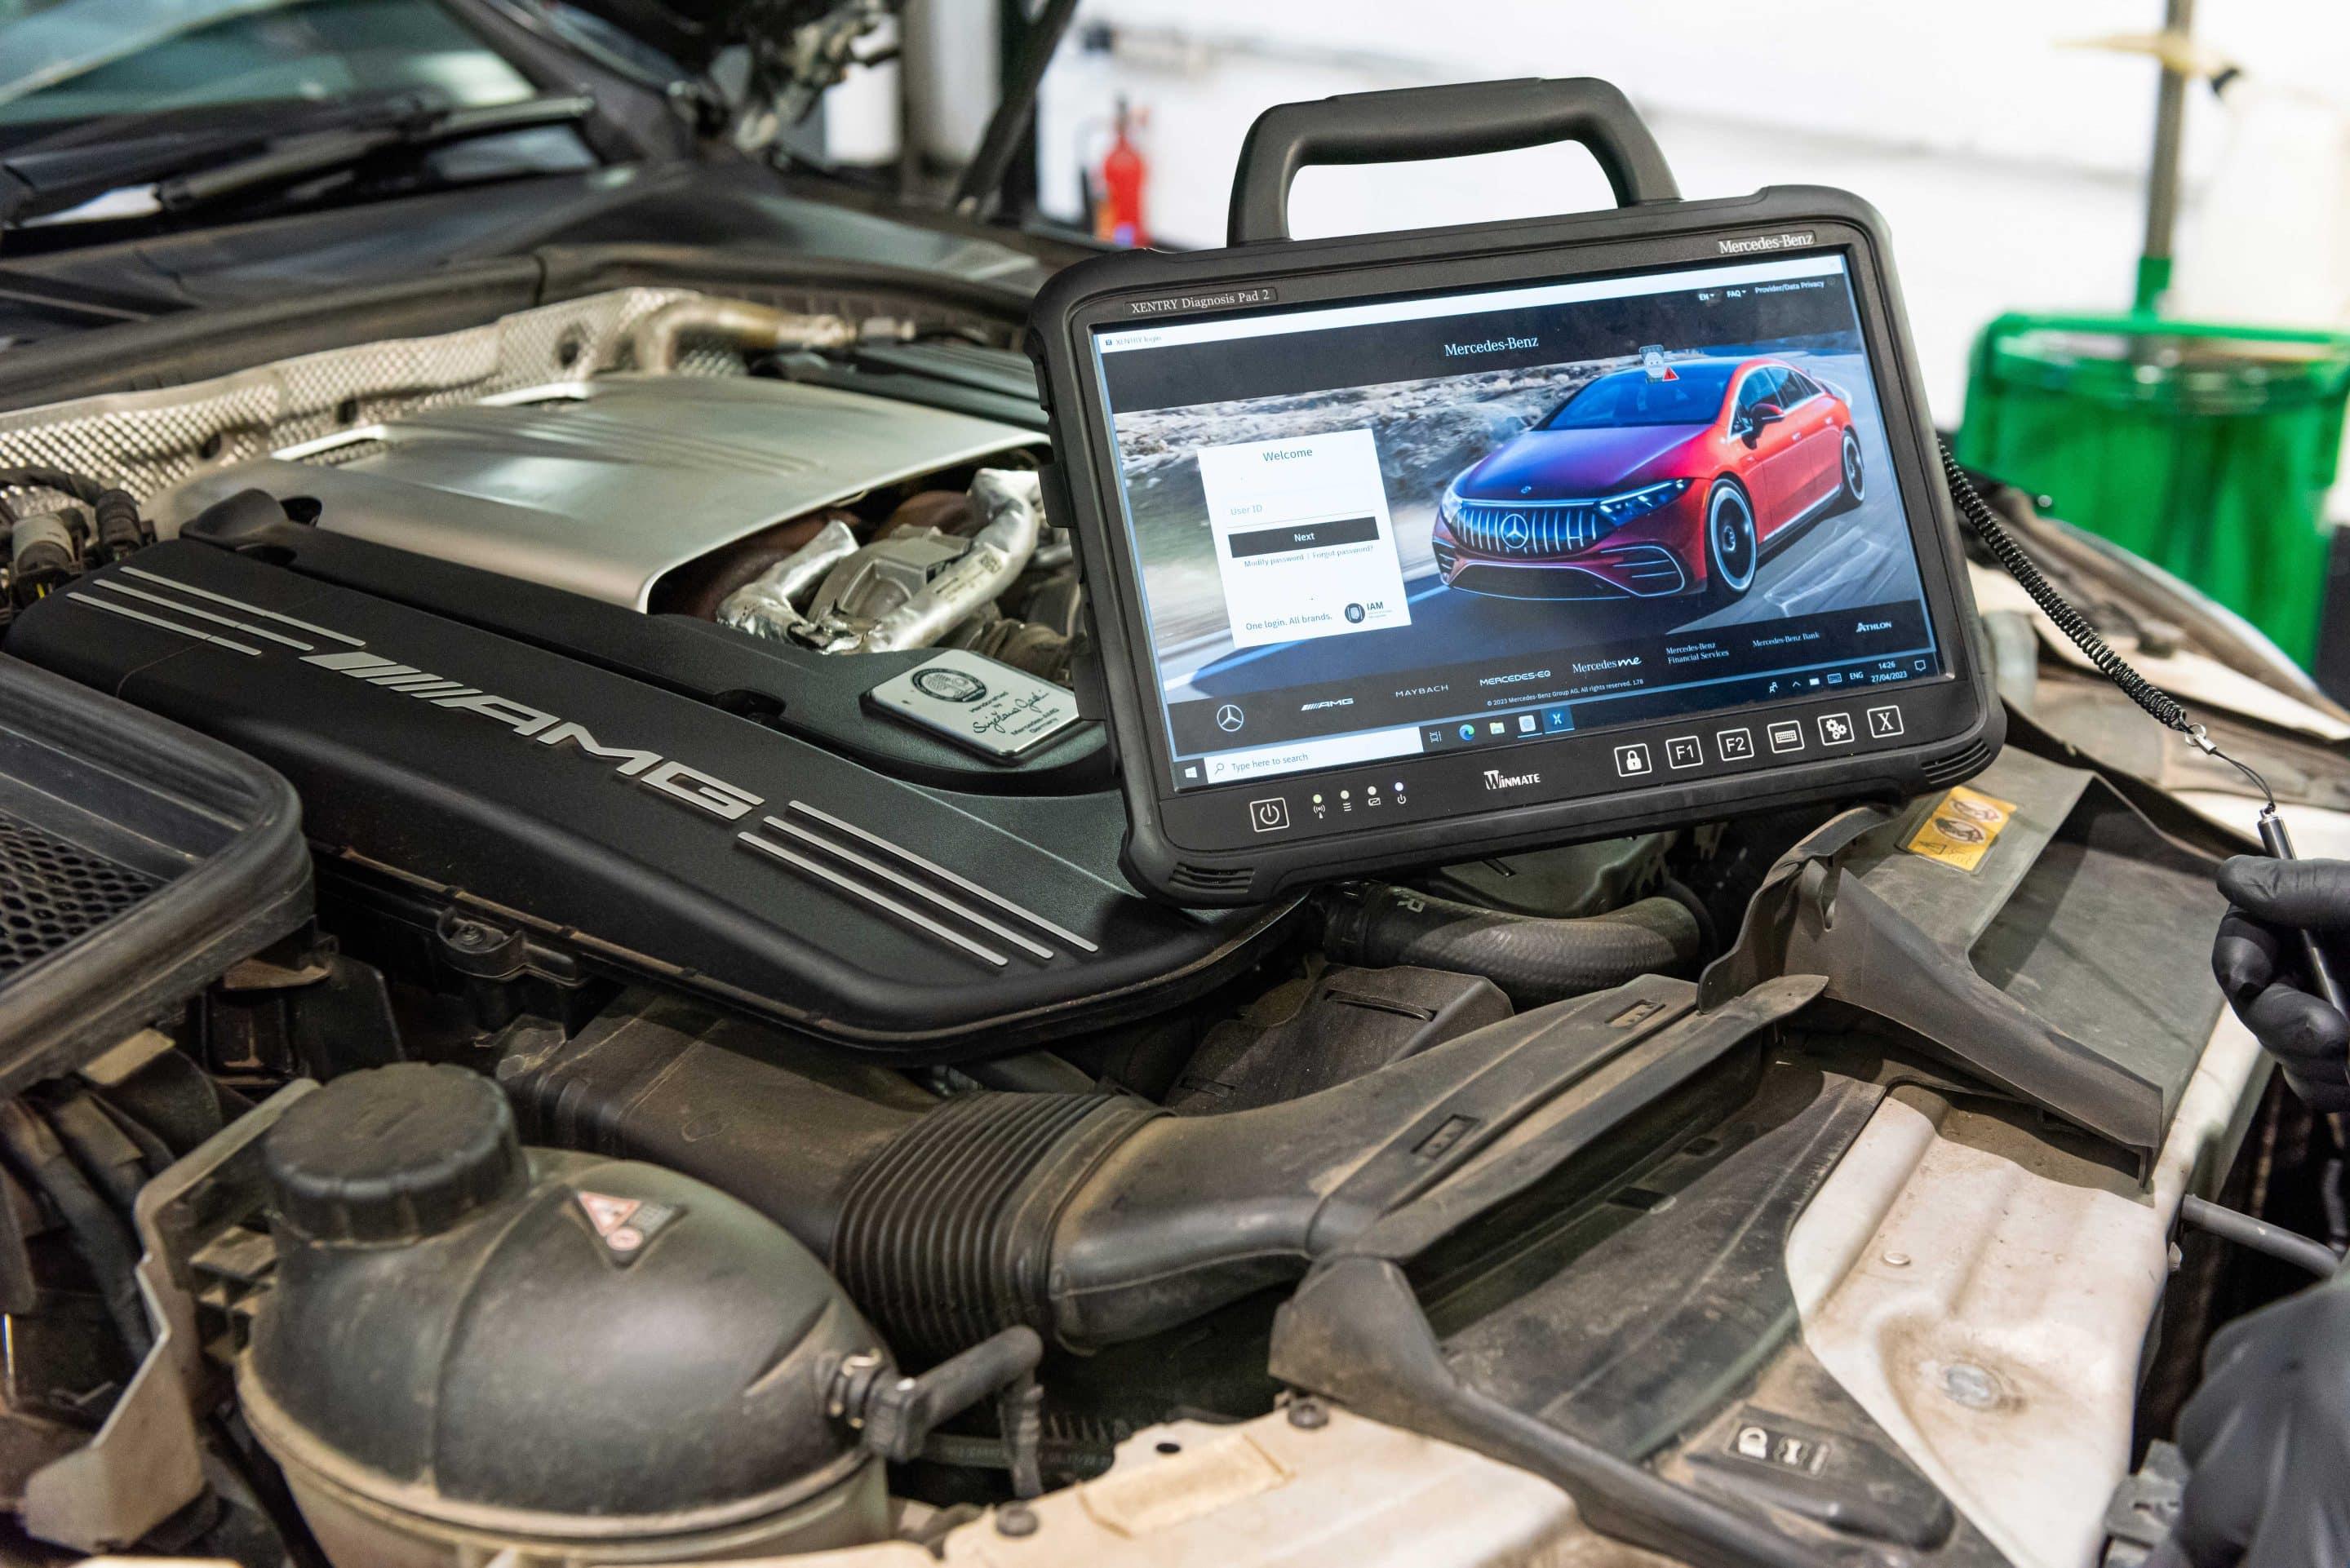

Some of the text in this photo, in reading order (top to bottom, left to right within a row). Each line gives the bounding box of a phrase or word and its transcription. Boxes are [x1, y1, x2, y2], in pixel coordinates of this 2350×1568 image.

[1718, 234, 1814, 254] Mercedes-Benz
[1755, 281, 1825, 294] Provider/Data Privacy
[1132, 290, 1270, 314] XENTRY Diagnosis Pad 2
[1443, 337, 1539, 356] Mercedes-Benz
[1262, 448, 1313, 462] Welcome
[1230, 504, 1263, 516] User ID
[1294, 532, 1315, 542] Next
[1313, 545, 1373, 560] Forgot password?
[1244, 554, 1304, 567] Modify password
[1367, 601, 1384, 610] IAM
[1246, 613, 1332, 631] One login. All brands.
[1856, 622, 1892, 634] ATHLON
[1752, 631, 1820, 647] Mercedes-Benz Bank
[1666, 642, 1716, 655] Mercedes-Benz
[1572, 656, 1643, 674] Mercedes me
[1668, 649, 1729, 666] Financial Services
[1878, 661, 1896, 670] 14:26
[1479, 670, 1551, 686] MERCEDES-EQ
[1850, 671, 1864, 680] ENG
[1871, 671, 1908, 683] 27/04/2023
[1395, 684, 1449, 698] MAYBACH
[1509, 693, 1550, 703] Mercedes-Benz
[1552, 690, 1569, 698] Group
[1590, 684, 1605, 693] rights
[1878, 712, 1894, 731] X
[1675, 744, 1695, 760] F1
[1726, 737, 1745, 752] F2
[1231, 752, 1308, 773] Type here to search
